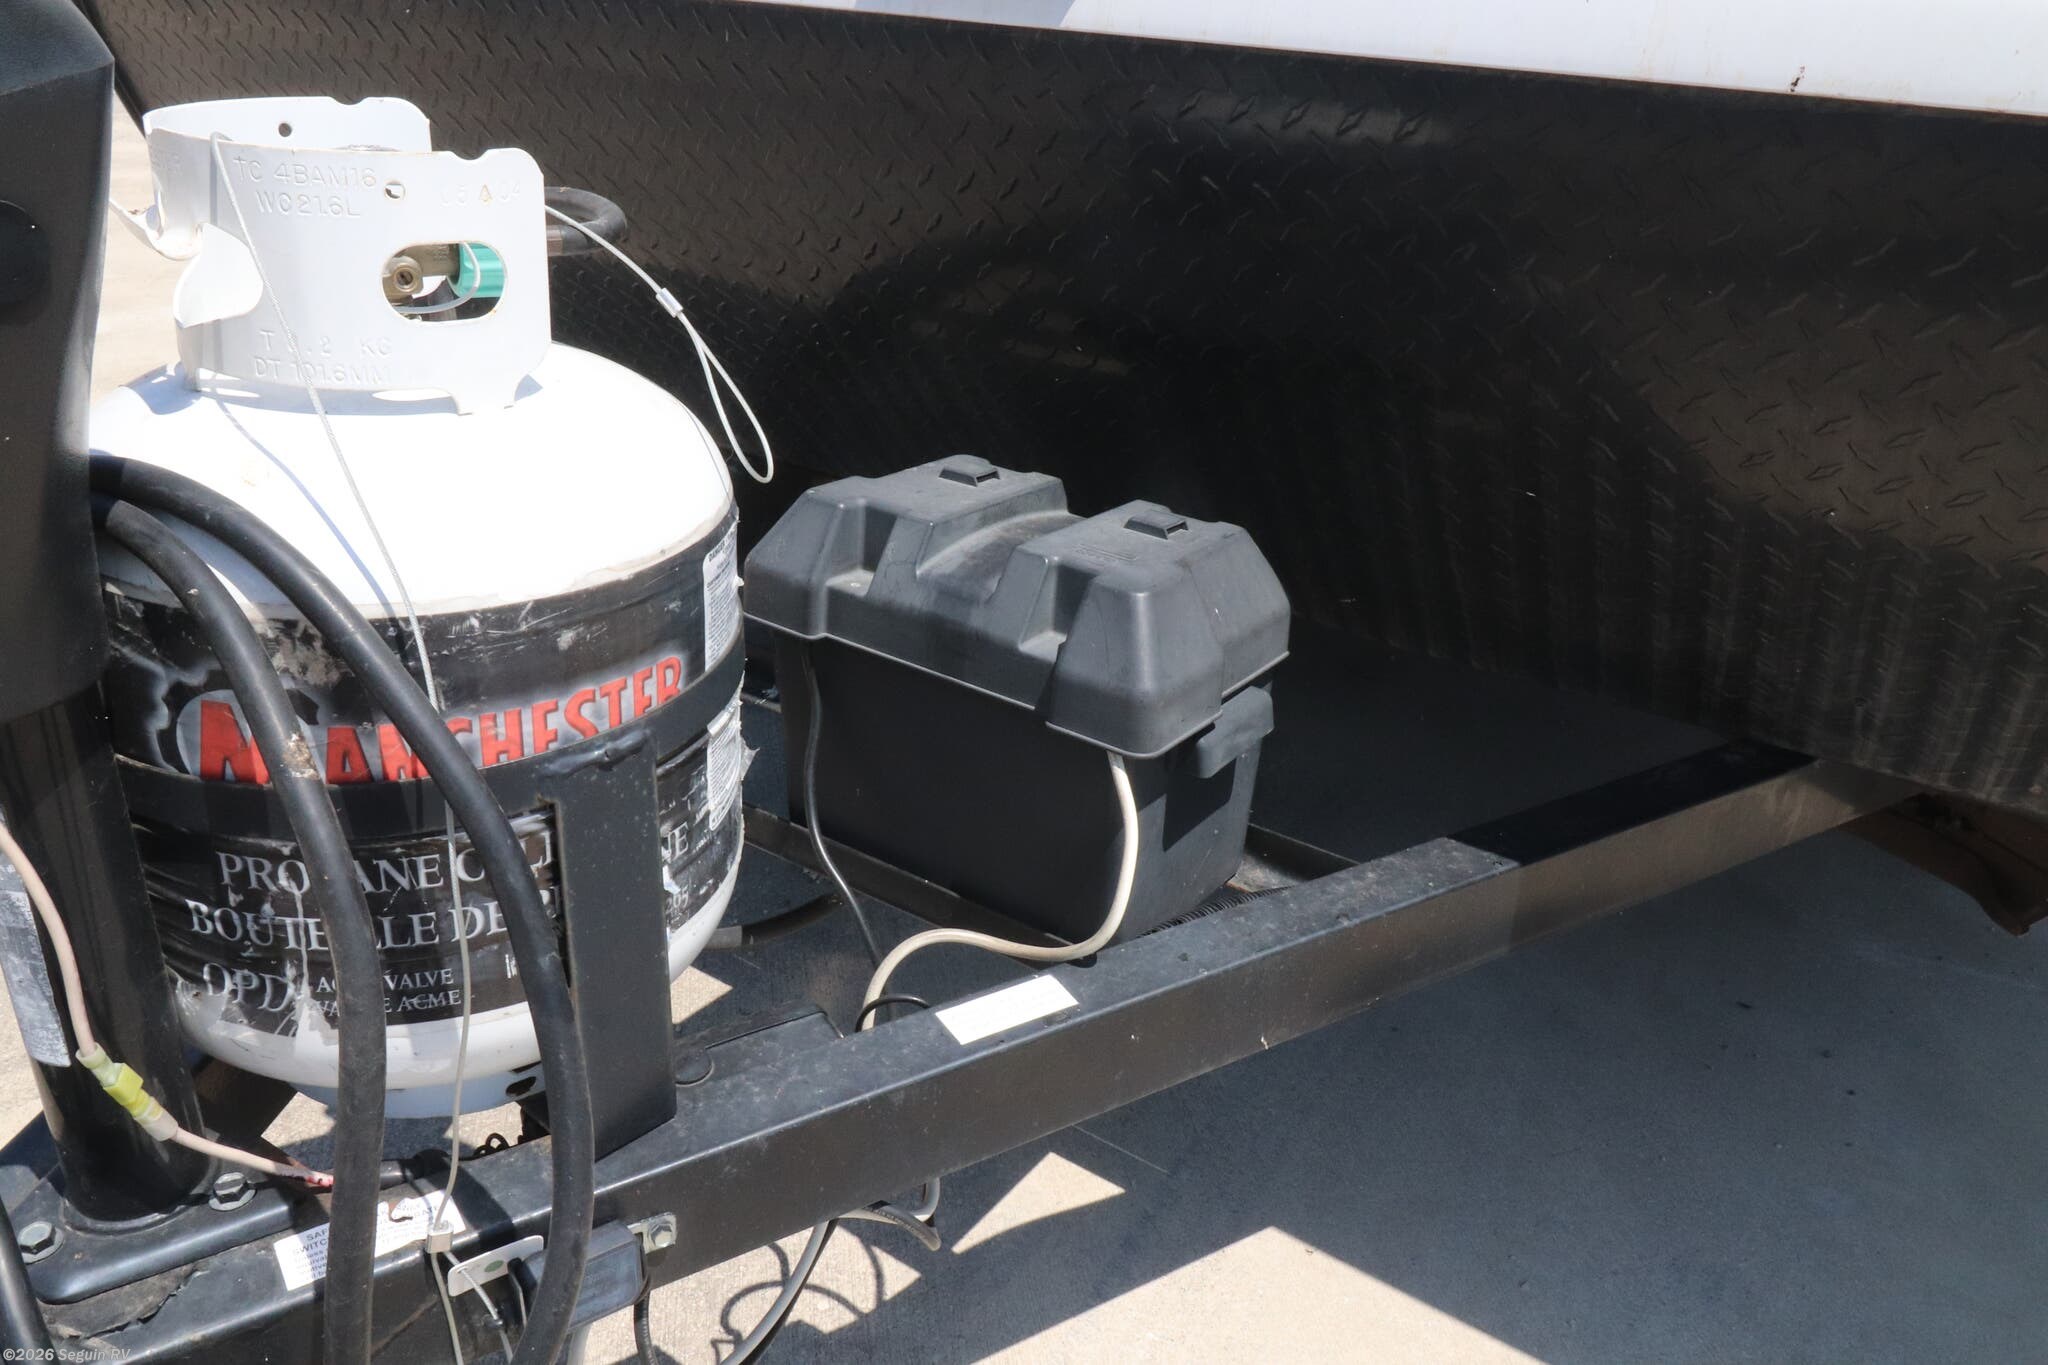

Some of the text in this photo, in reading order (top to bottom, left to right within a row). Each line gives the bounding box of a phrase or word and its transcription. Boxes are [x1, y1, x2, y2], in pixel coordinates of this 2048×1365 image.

[200, 655, 682, 785] MANHESTER
[216, 852, 444, 894] PROANE
[397, 989, 462, 1013] ACME
